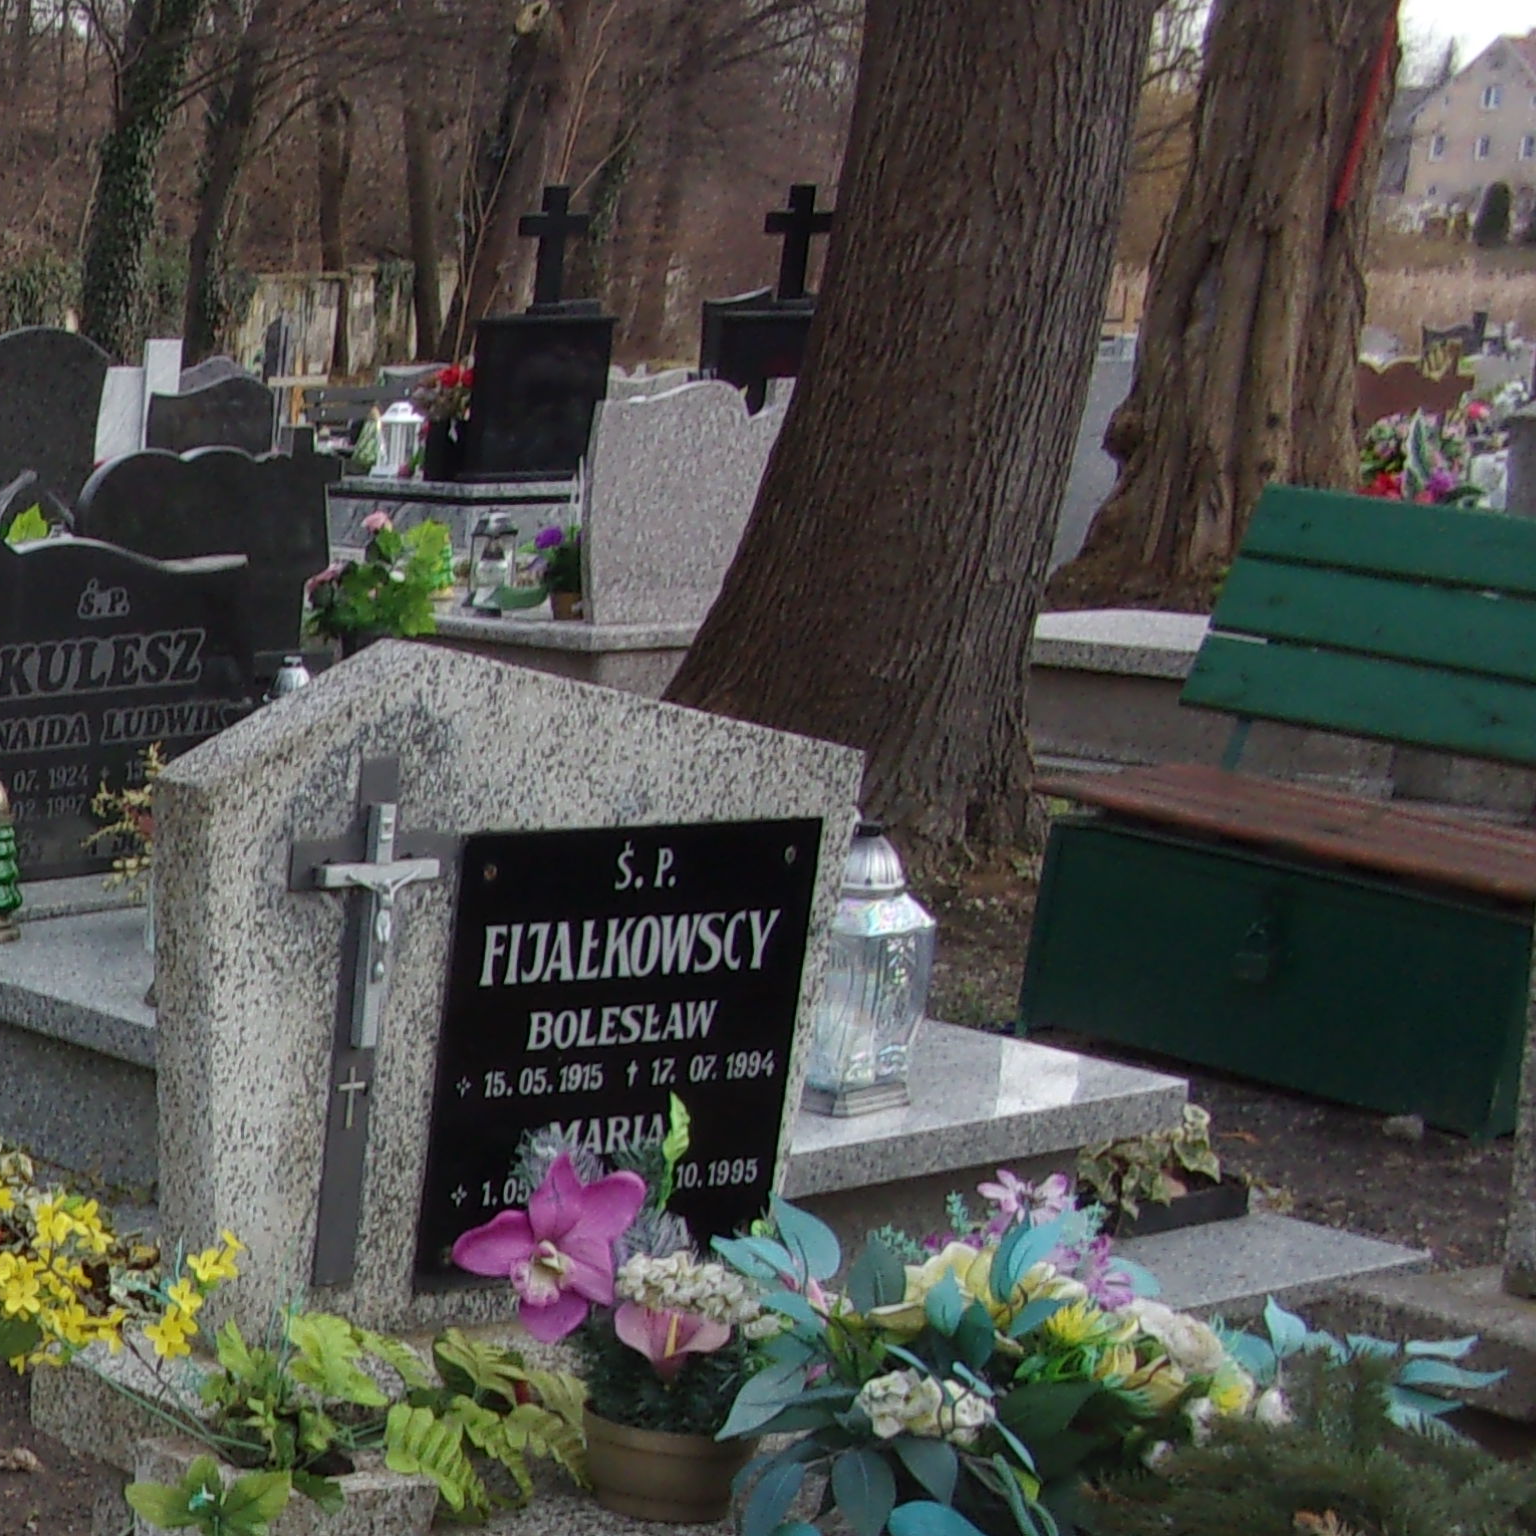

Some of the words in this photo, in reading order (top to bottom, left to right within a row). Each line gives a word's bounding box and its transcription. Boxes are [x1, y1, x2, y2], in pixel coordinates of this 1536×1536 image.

[479, 909, 781, 987] FIJAŁKOWSCY
[527, 1000, 719, 1052] BOLESŁAW
[548, 1114, 667, 1156] MARIA
